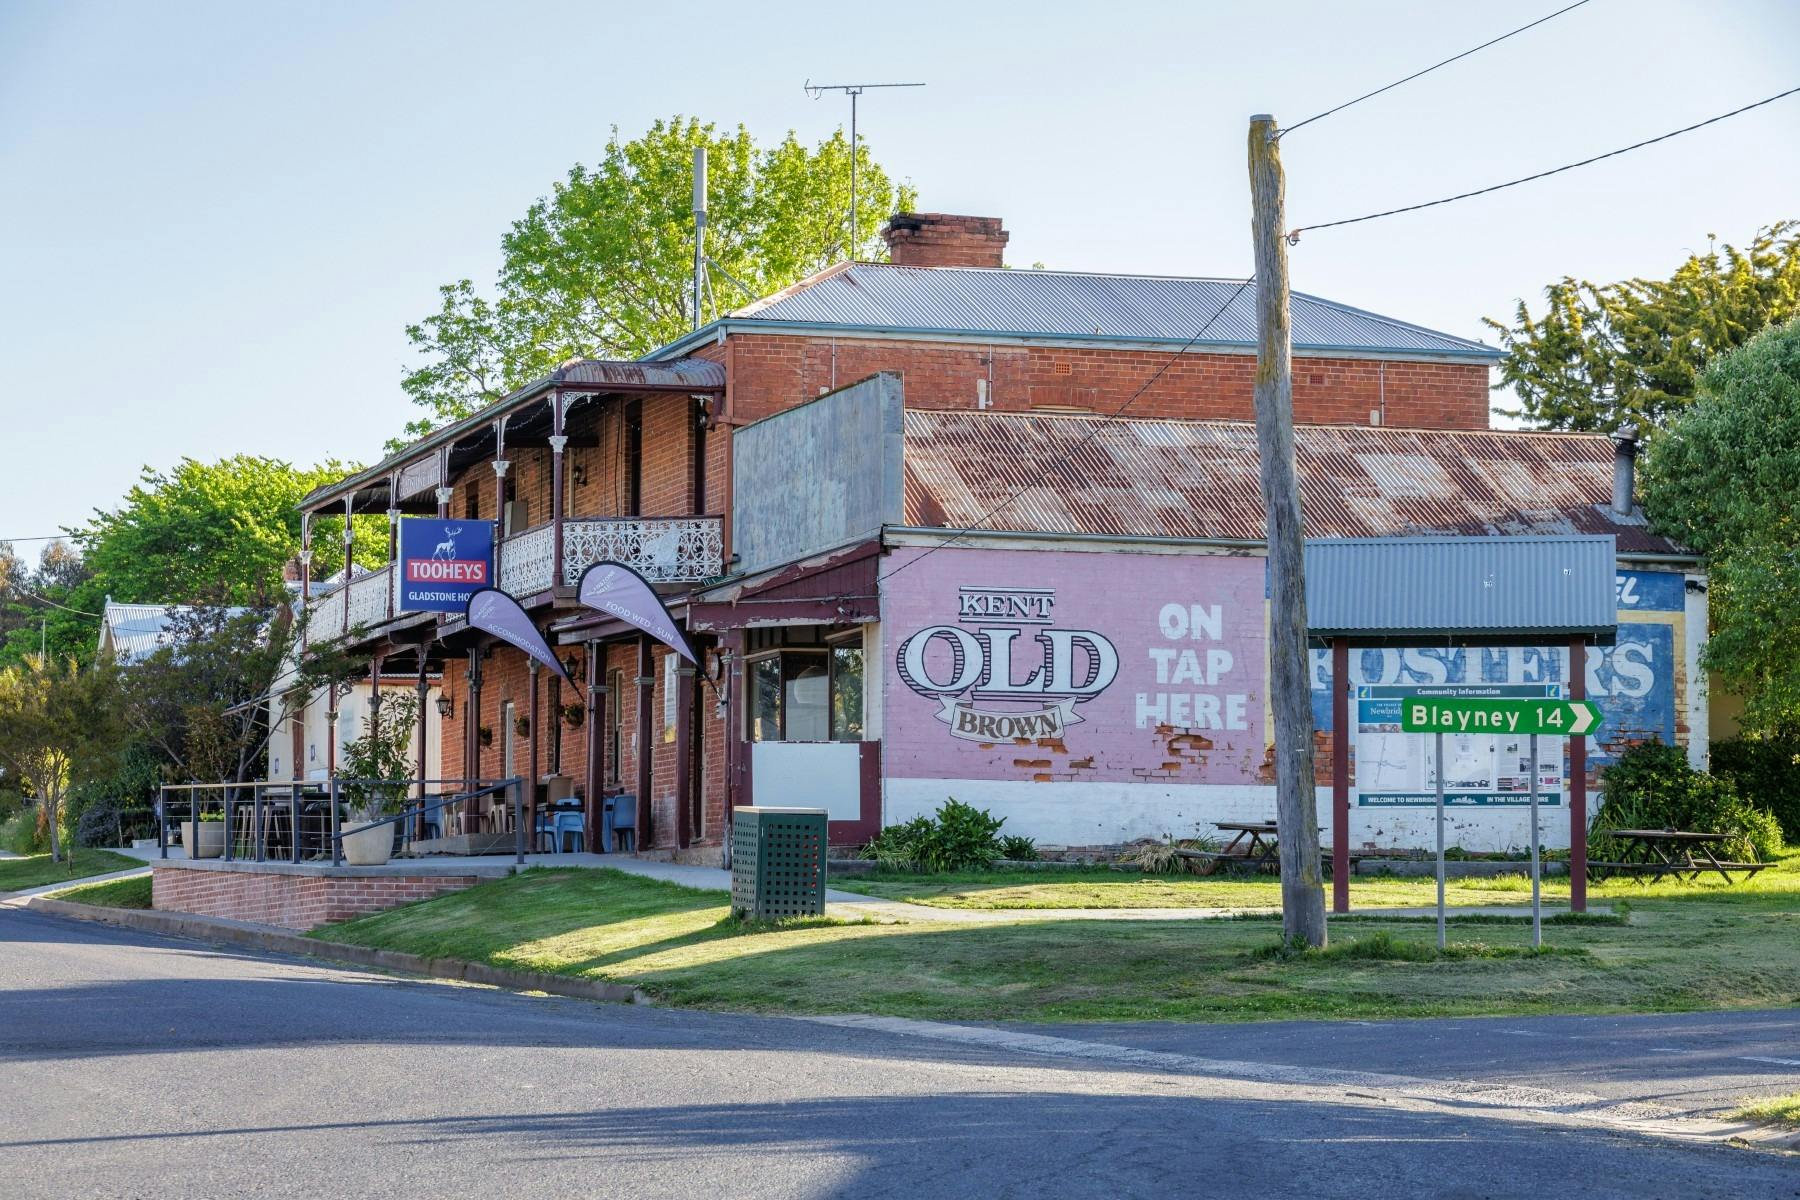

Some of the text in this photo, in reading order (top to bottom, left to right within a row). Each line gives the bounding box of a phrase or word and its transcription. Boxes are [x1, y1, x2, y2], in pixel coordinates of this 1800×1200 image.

[411, 562, 483, 580] TOOHEYS
[408, 591, 471, 602] GLADSTONE HO
[959, 593, 1056, 618] KENT
[605, 600, 631, 617] FOOD
[632, 612, 651, 628] WED
[656, 626, 674, 642] SUN
[1158, 603, 1223, 641] ON
[488, 623, 551, 663] ACCOMMODATION
[896, 625, 1120, 702] OLD
[1148, 648, 1234, 686] TAP
[1417, 688, 1457, 697] Community
[957, 708, 1061, 739] BROWN
[1135, 692, 1248, 731] HERE
[1412, 704, 1564, 732] Blayney 14
